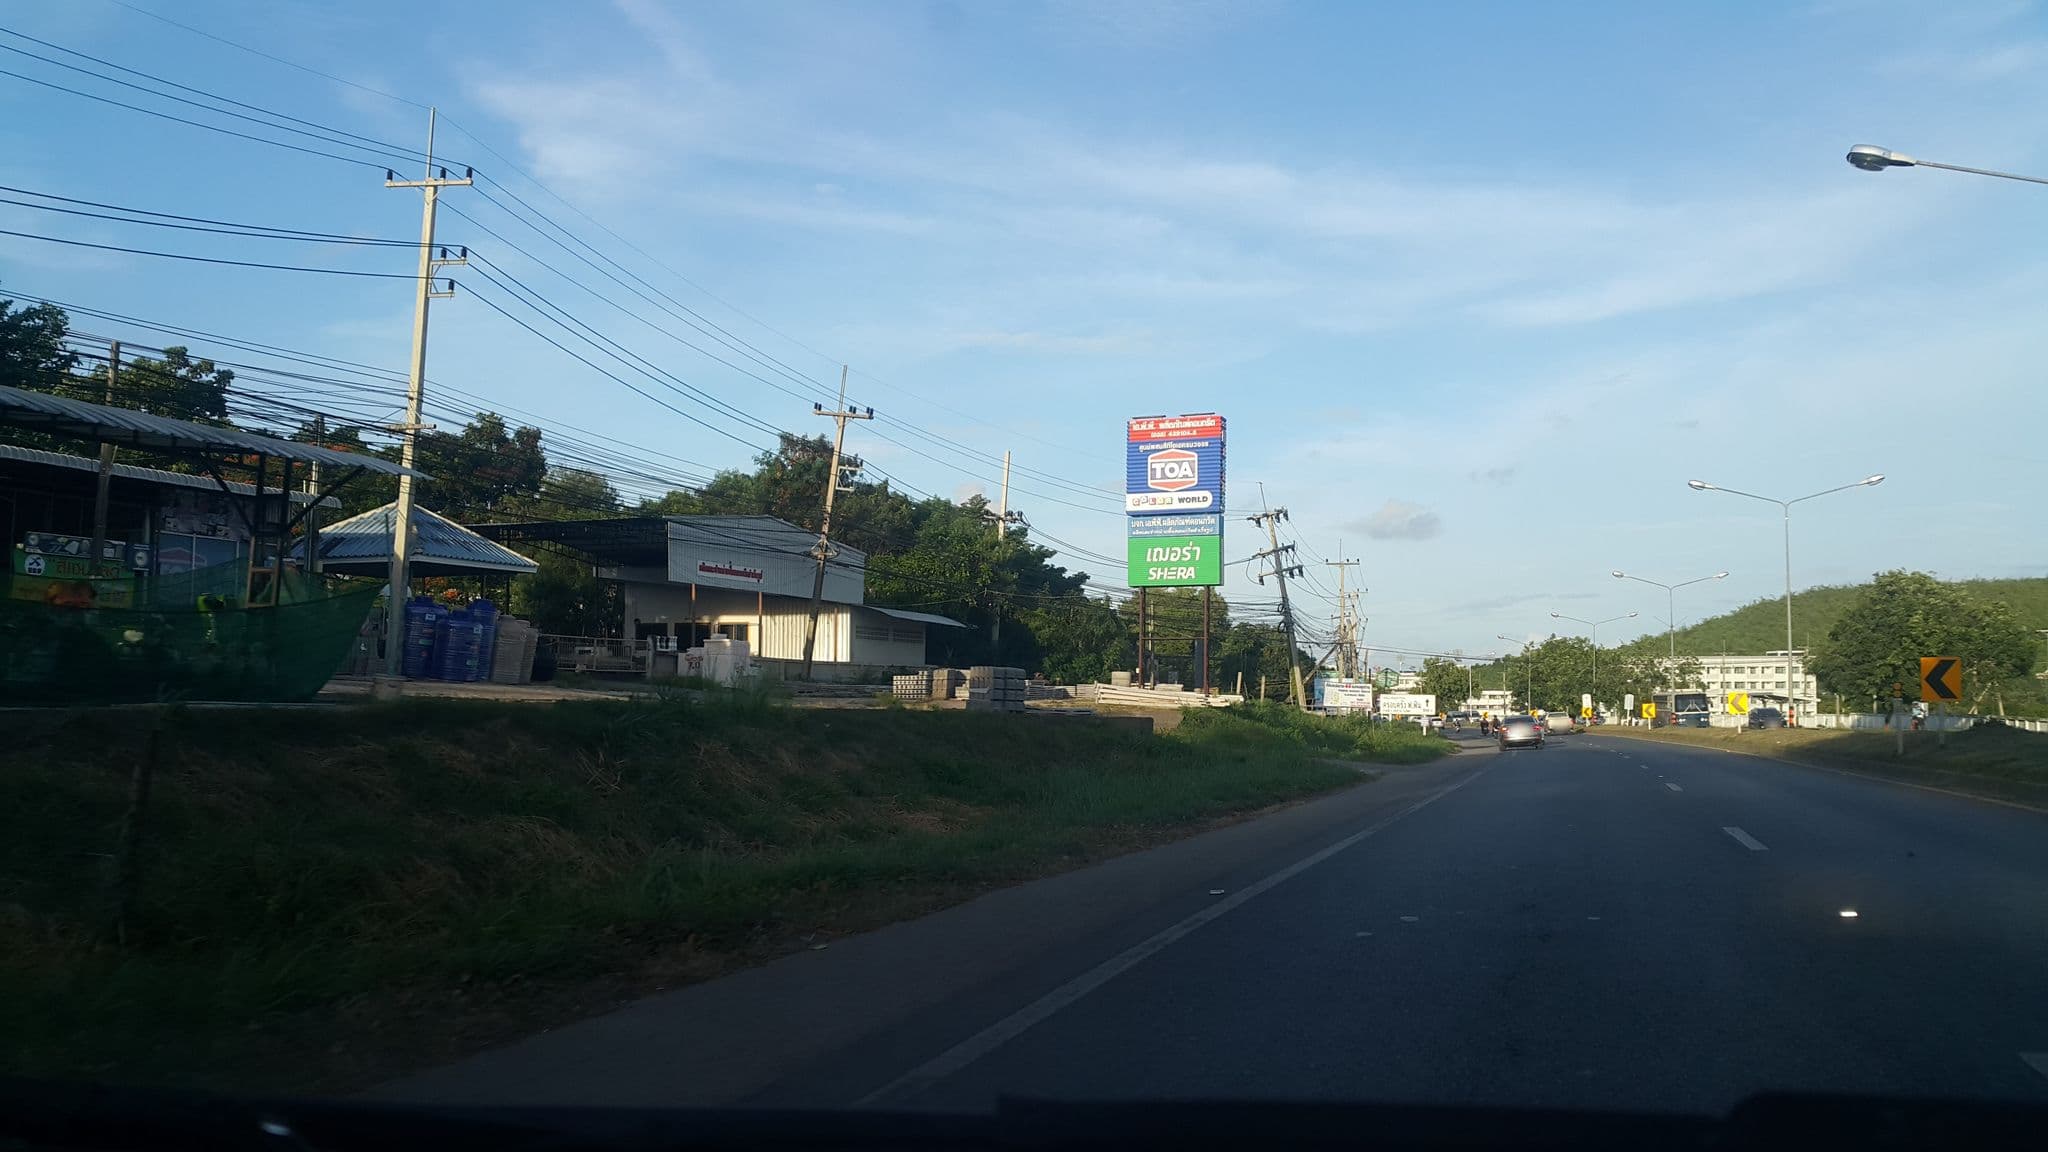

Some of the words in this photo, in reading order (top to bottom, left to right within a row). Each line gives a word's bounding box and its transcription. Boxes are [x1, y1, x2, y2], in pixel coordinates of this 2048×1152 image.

[1151, 461, 1194, 480] TOA
[1177, 495, 1208, 504] WORLD
[1147, 566, 1196, 580] SHERA
